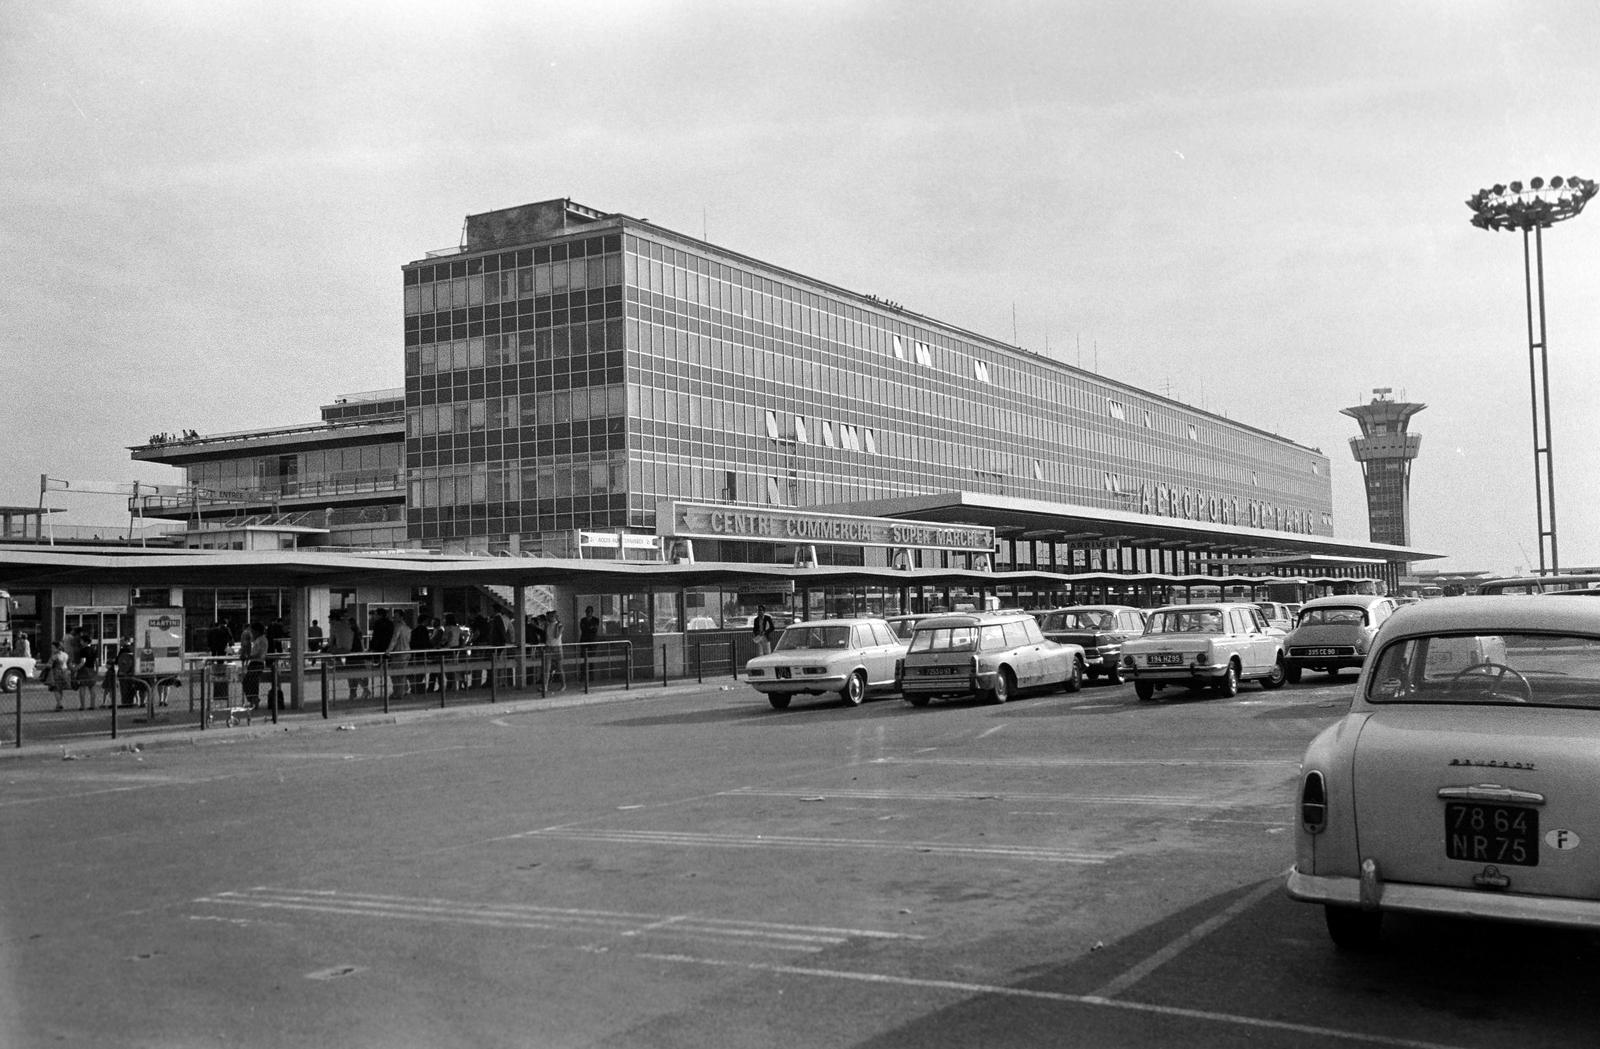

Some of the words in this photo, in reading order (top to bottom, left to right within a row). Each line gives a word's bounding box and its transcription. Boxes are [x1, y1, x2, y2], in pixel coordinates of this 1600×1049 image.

[711, 509, 778, 536] CENTRE
[786, 515, 876, 542] COMMERCIAL
[893, 525, 931, 545] SUPER
[1275, 506, 1314, 536] PARIS
[1452, 833, 1489, 859] NR
[1495, 836, 1528, 862] 75
[1557, 830, 1569, 849] F
